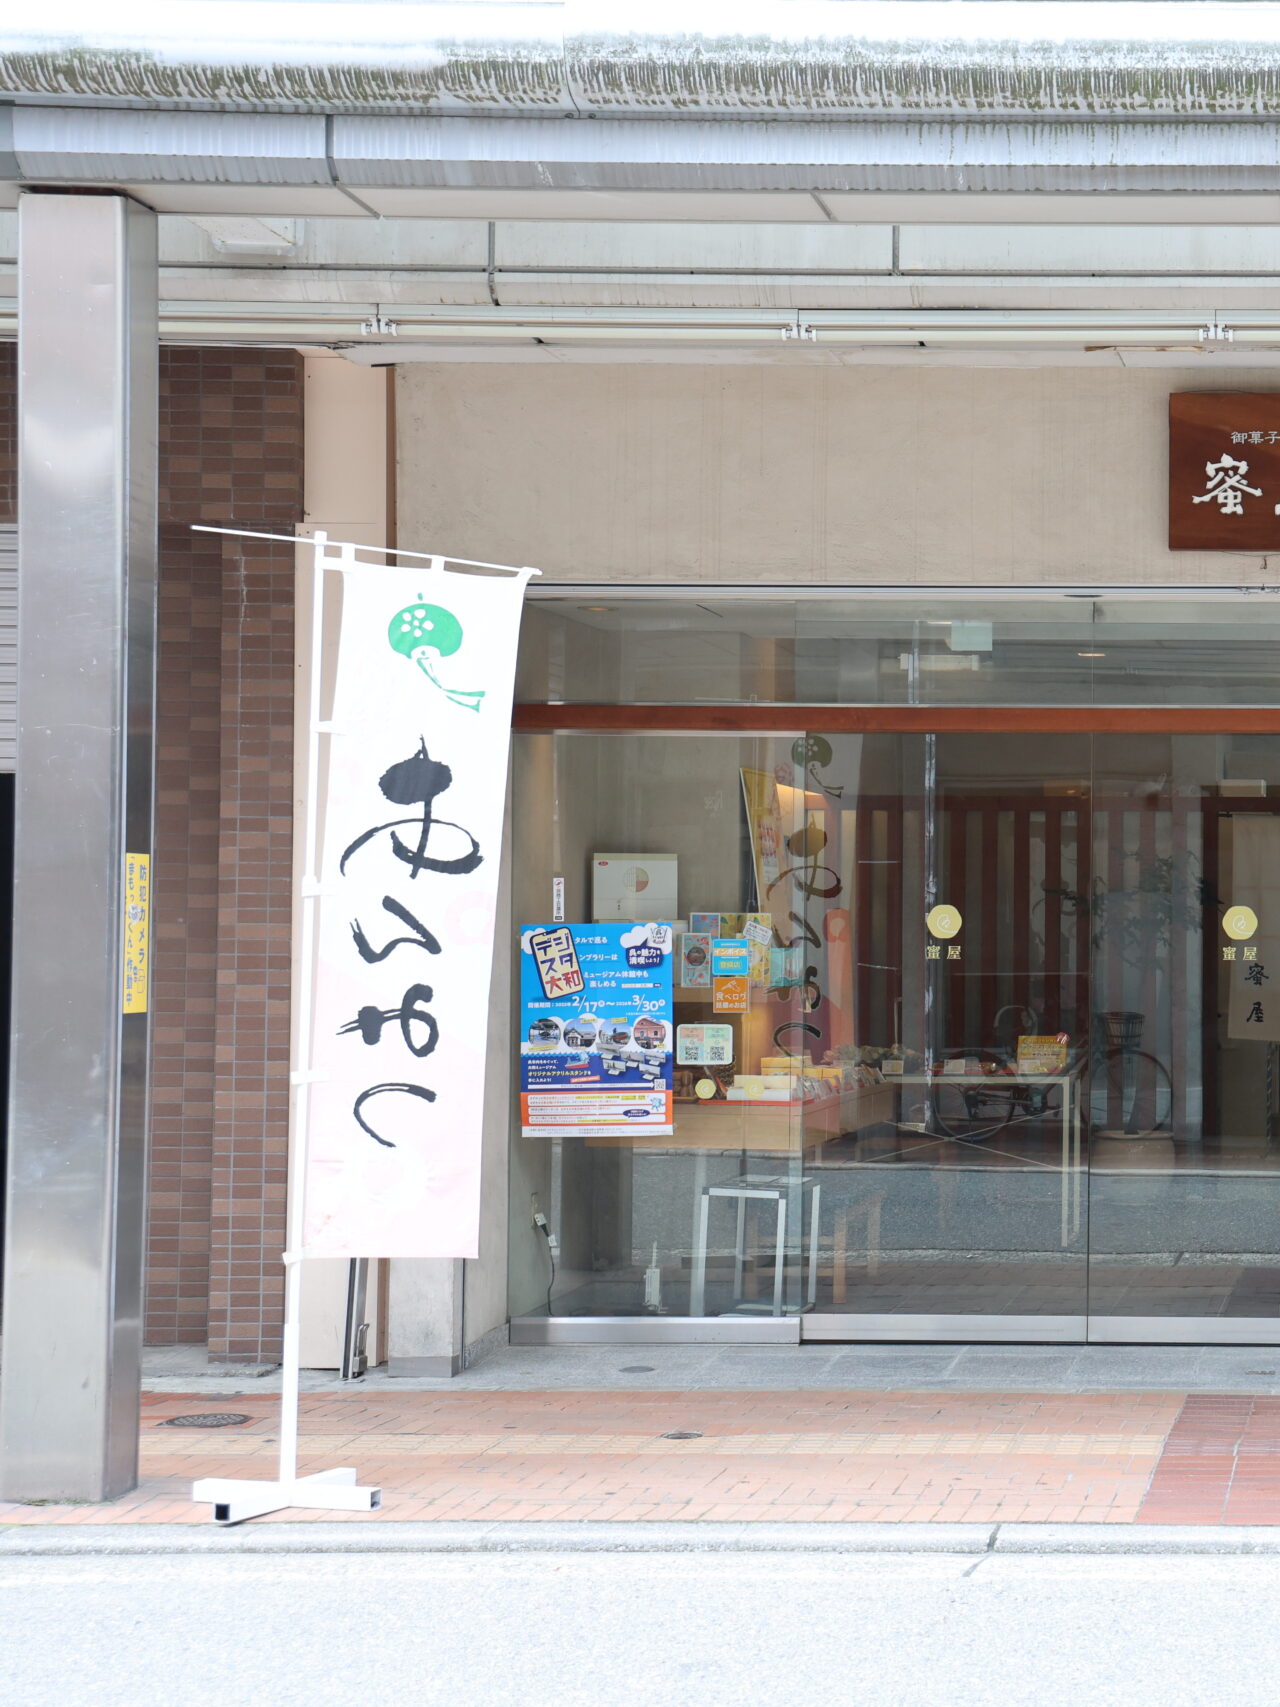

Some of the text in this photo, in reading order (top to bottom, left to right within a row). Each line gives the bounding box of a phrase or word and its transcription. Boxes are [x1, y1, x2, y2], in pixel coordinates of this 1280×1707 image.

[1222, 946, 1258, 961] 蜜屋
[715, 992, 747, 1001] 食べログ
